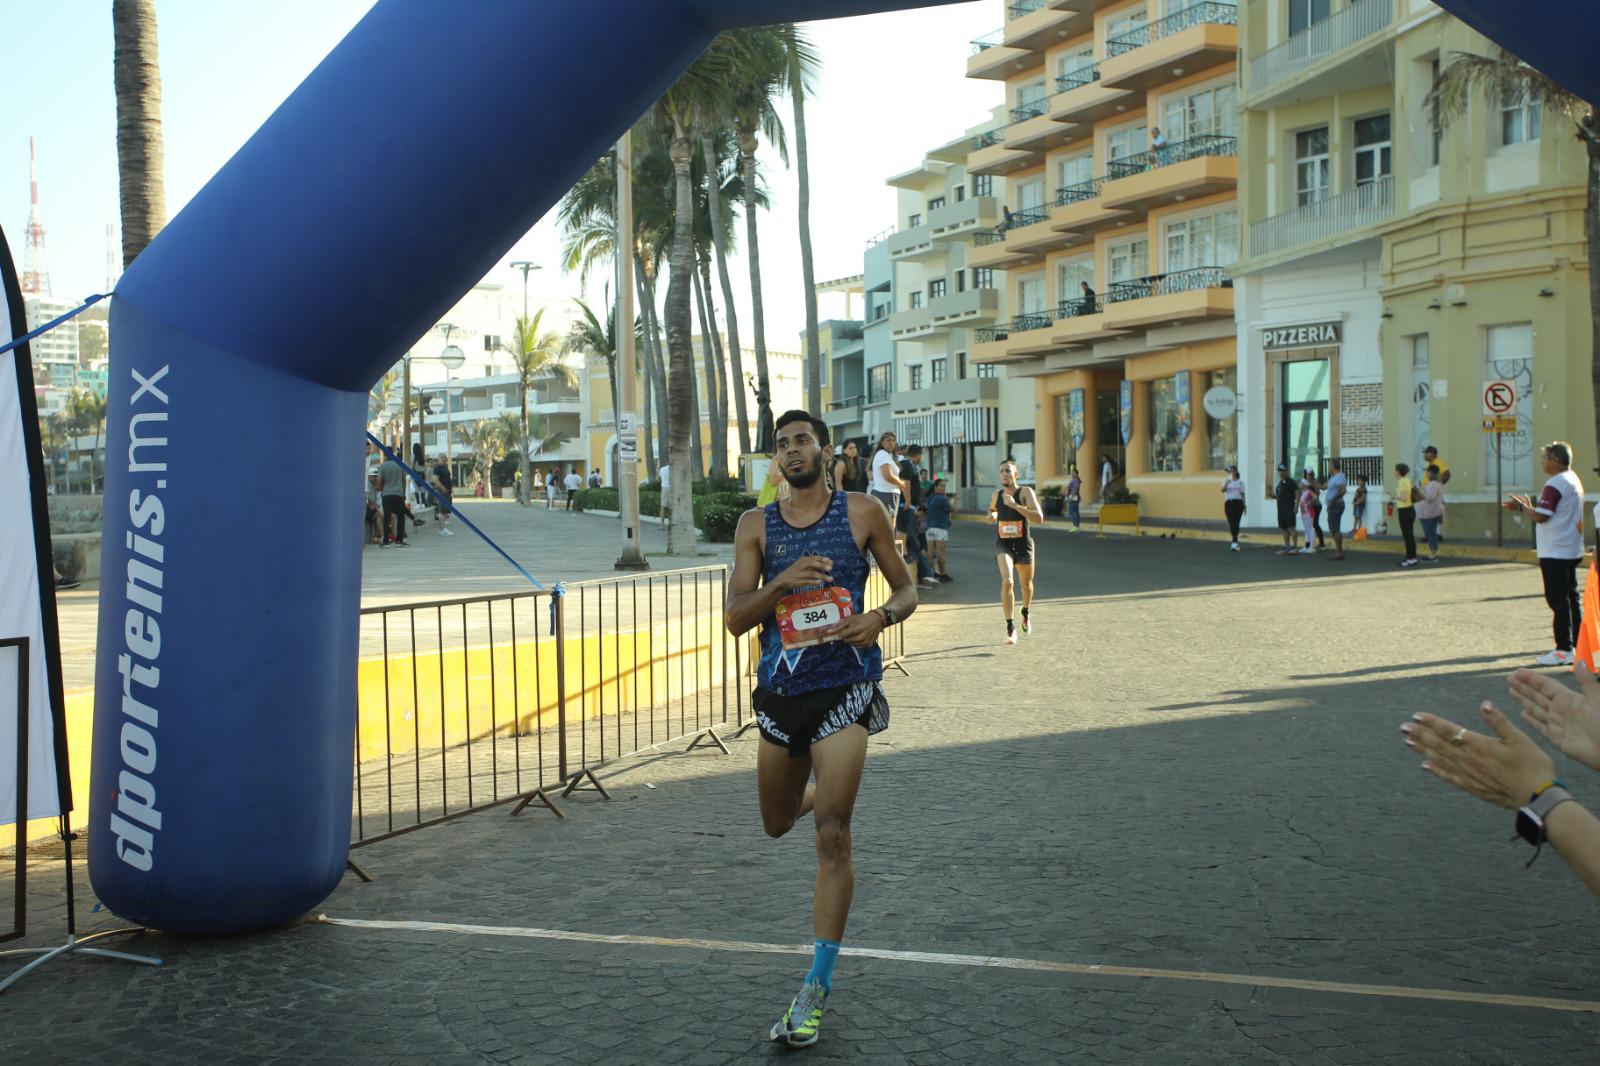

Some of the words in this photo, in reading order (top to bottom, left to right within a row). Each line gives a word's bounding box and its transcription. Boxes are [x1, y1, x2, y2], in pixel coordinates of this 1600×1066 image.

[1263, 324, 1336, 346] PIZZERIA
[1492, 388, 1506, 406] E
[110, 364, 169, 872] dportenis.mx
[803, 609, 828, 624] 384
